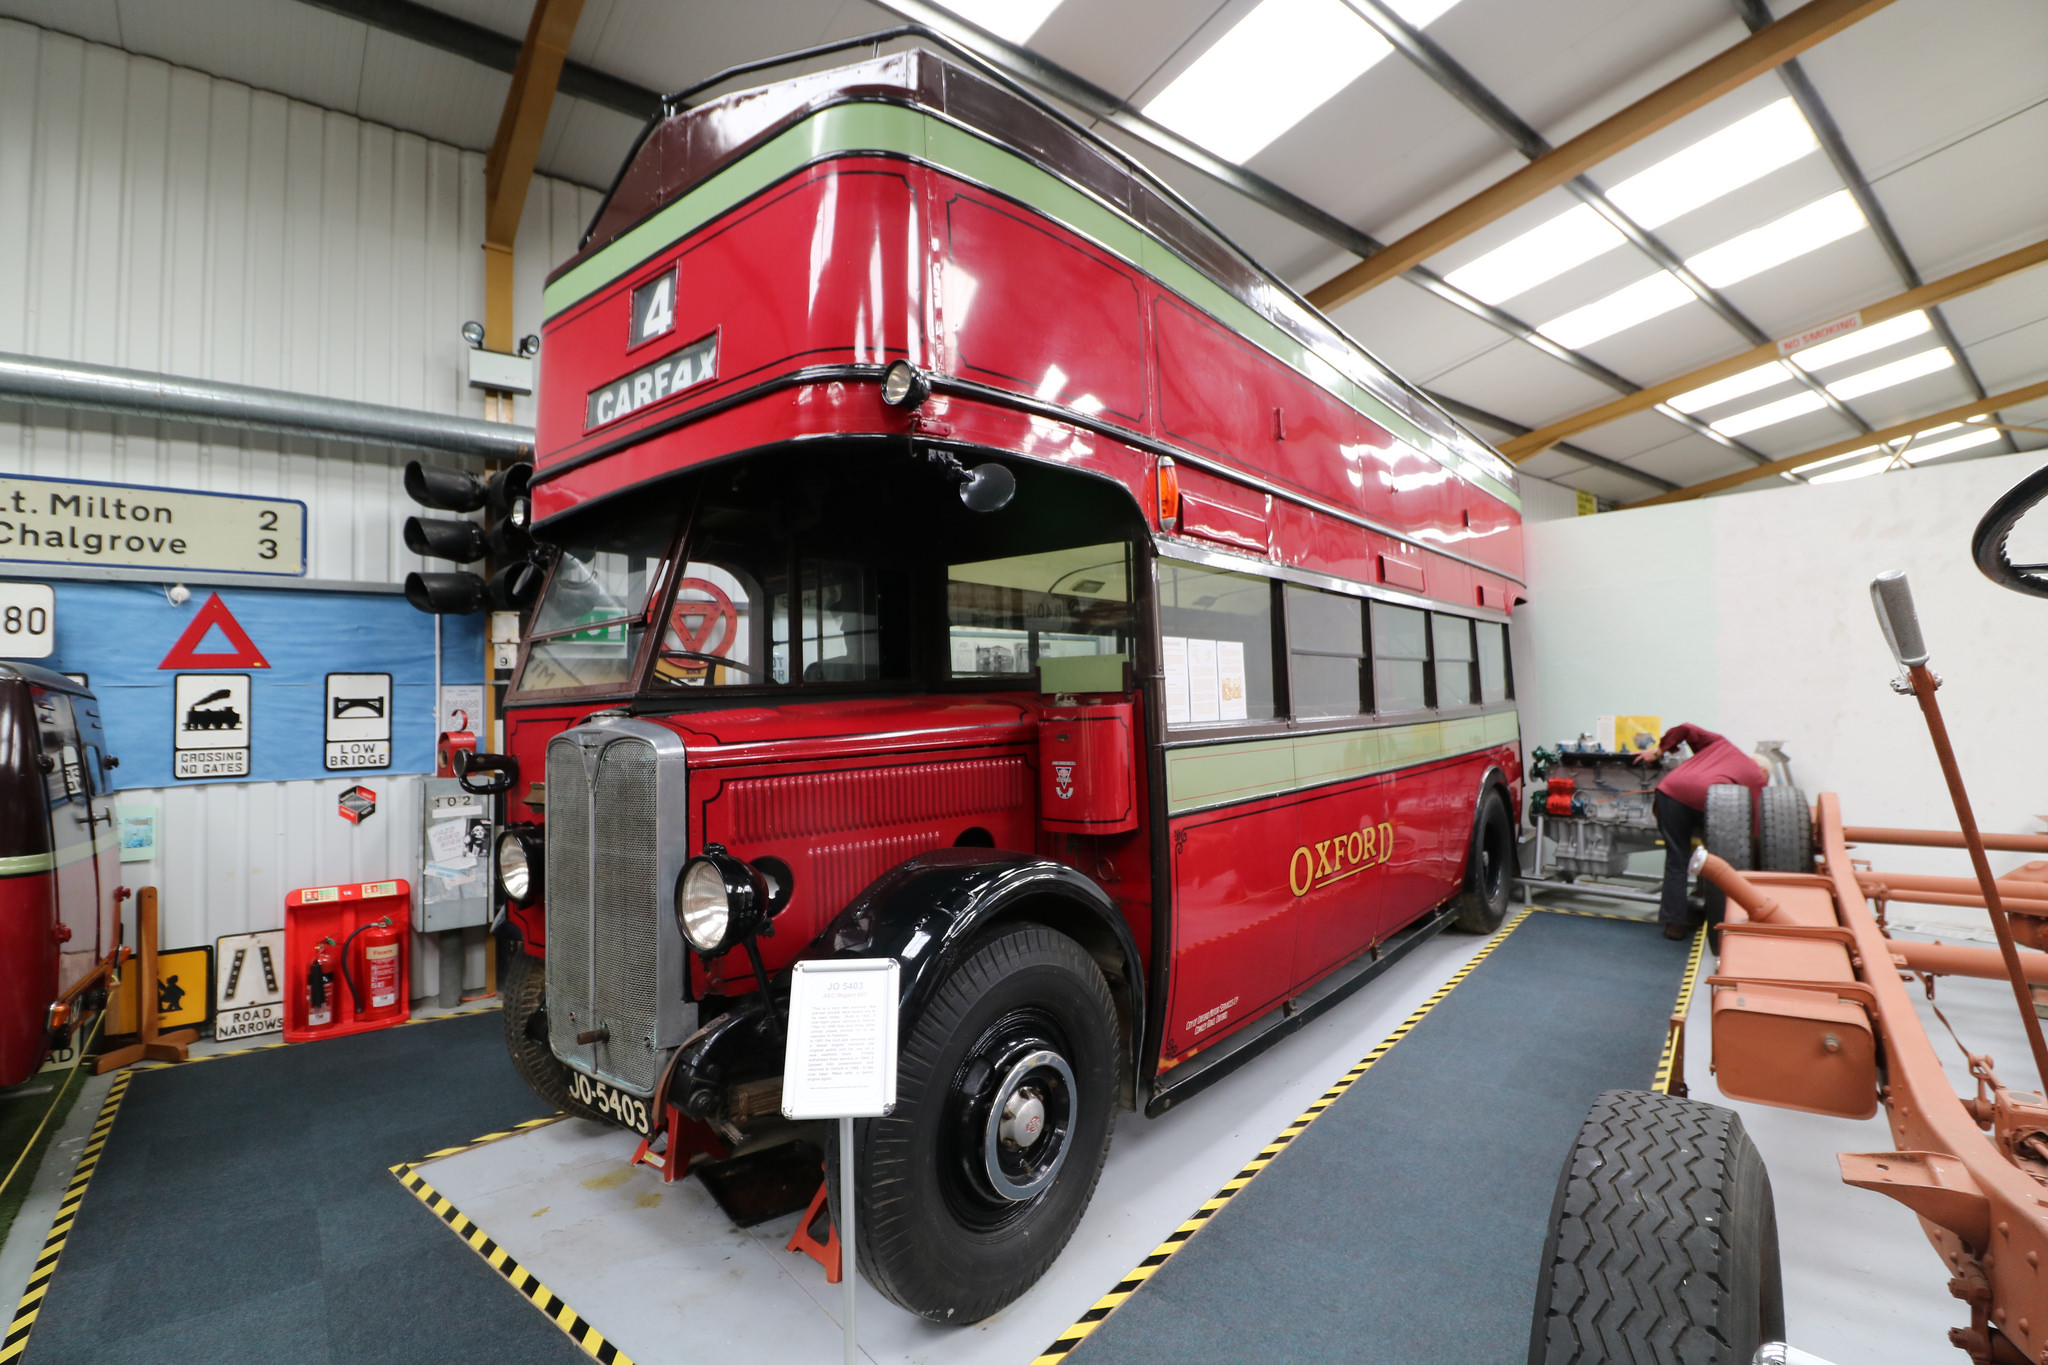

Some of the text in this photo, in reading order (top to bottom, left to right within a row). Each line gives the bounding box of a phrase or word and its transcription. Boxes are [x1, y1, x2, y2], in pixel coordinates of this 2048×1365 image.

[643, 277, 672, 338] 4
[1783, 317, 1857, 350] NO SMOKING
[597, 345, 717, 425] CARFAX
[0, 491, 278, 531] t. Milton 2
[0, 521, 278, 559] Chalgrove 3
[181, 751, 243, 763] CROSSING
[340, 743, 375, 755] LOW
[181, 762, 243, 774] NO GATES
[330, 754, 386, 766] BRIDGE
[1289, 821, 1394, 898] OXFORD
[827, 982, 840, 991] JO
[233, 1008, 271, 1023] ROAD
[218, 1018, 284, 1038] NARROWS
